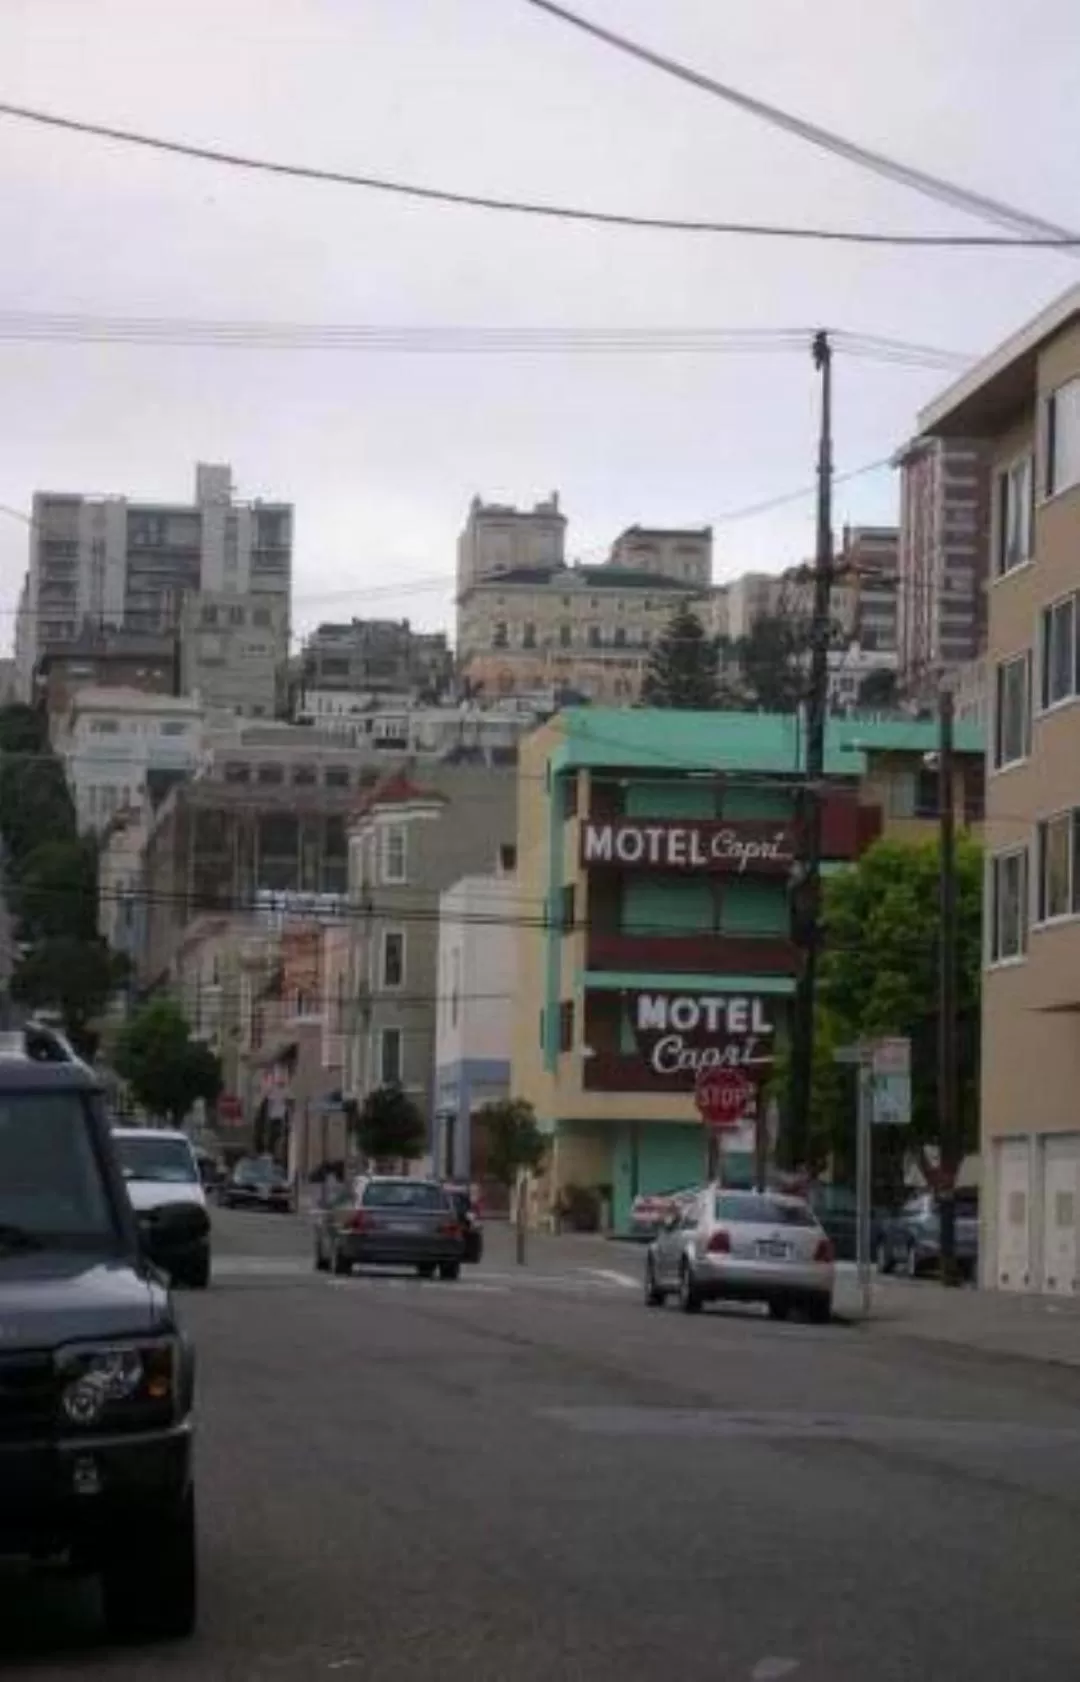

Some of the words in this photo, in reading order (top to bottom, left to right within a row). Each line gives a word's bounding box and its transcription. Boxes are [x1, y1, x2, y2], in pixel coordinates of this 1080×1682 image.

[585, 825, 708, 865] MOTEL
[711, 828, 794, 873] Capri
[637, 995, 774, 1033] MOTEL
[652, 1034, 774, 1075] Capri
[700, 1086, 748, 1109] STOP
